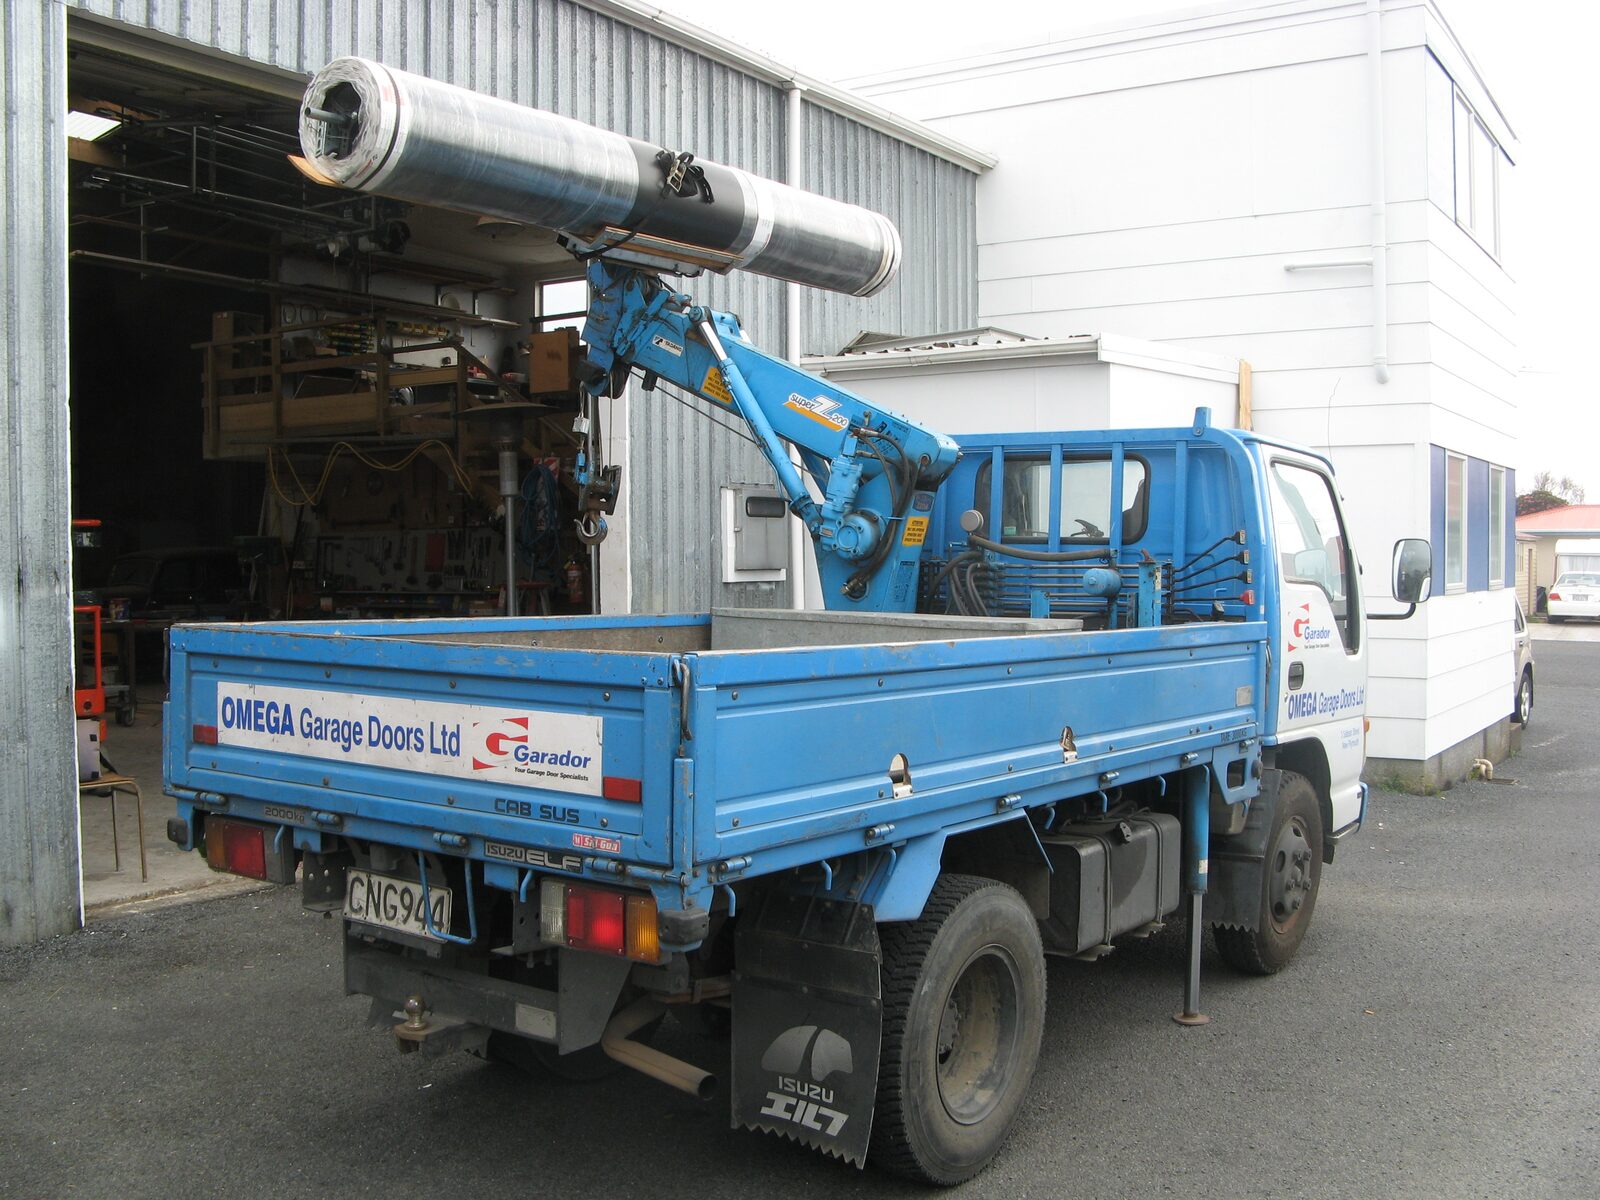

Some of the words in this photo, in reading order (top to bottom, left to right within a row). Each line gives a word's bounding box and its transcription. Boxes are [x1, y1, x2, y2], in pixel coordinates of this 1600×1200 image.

[790, 394, 815, 410] super
[832, 413, 849, 427] 200
[1304, 625, 1331, 641] Garador
[1288, 691, 1317, 720] OMEGA
[1319, 692, 1340, 717] Garage
[1340, 688, 1356, 709] Doors
[221, 696, 296, 737] OMEGA
[300, 707, 364, 753] Garage
[368, 715, 425, 753] Doors
[430, 721, 461, 757] Ltd
[514, 744, 592, 769] Garador
[514, 766, 526, 774] Your
[526, 768, 546, 777] Garage
[546, 770, 560, 778] Door
[559, 772, 589, 782] Specialists
[494, 798, 532, 817] CAB
[539, 804, 580, 824] SUS
[487, 844, 523, 859] ISUZU
[526, 849, 582, 870] ELF
[348, 876, 445, 932] CNG944
[778, 1075, 834, 1104] ISUZU
